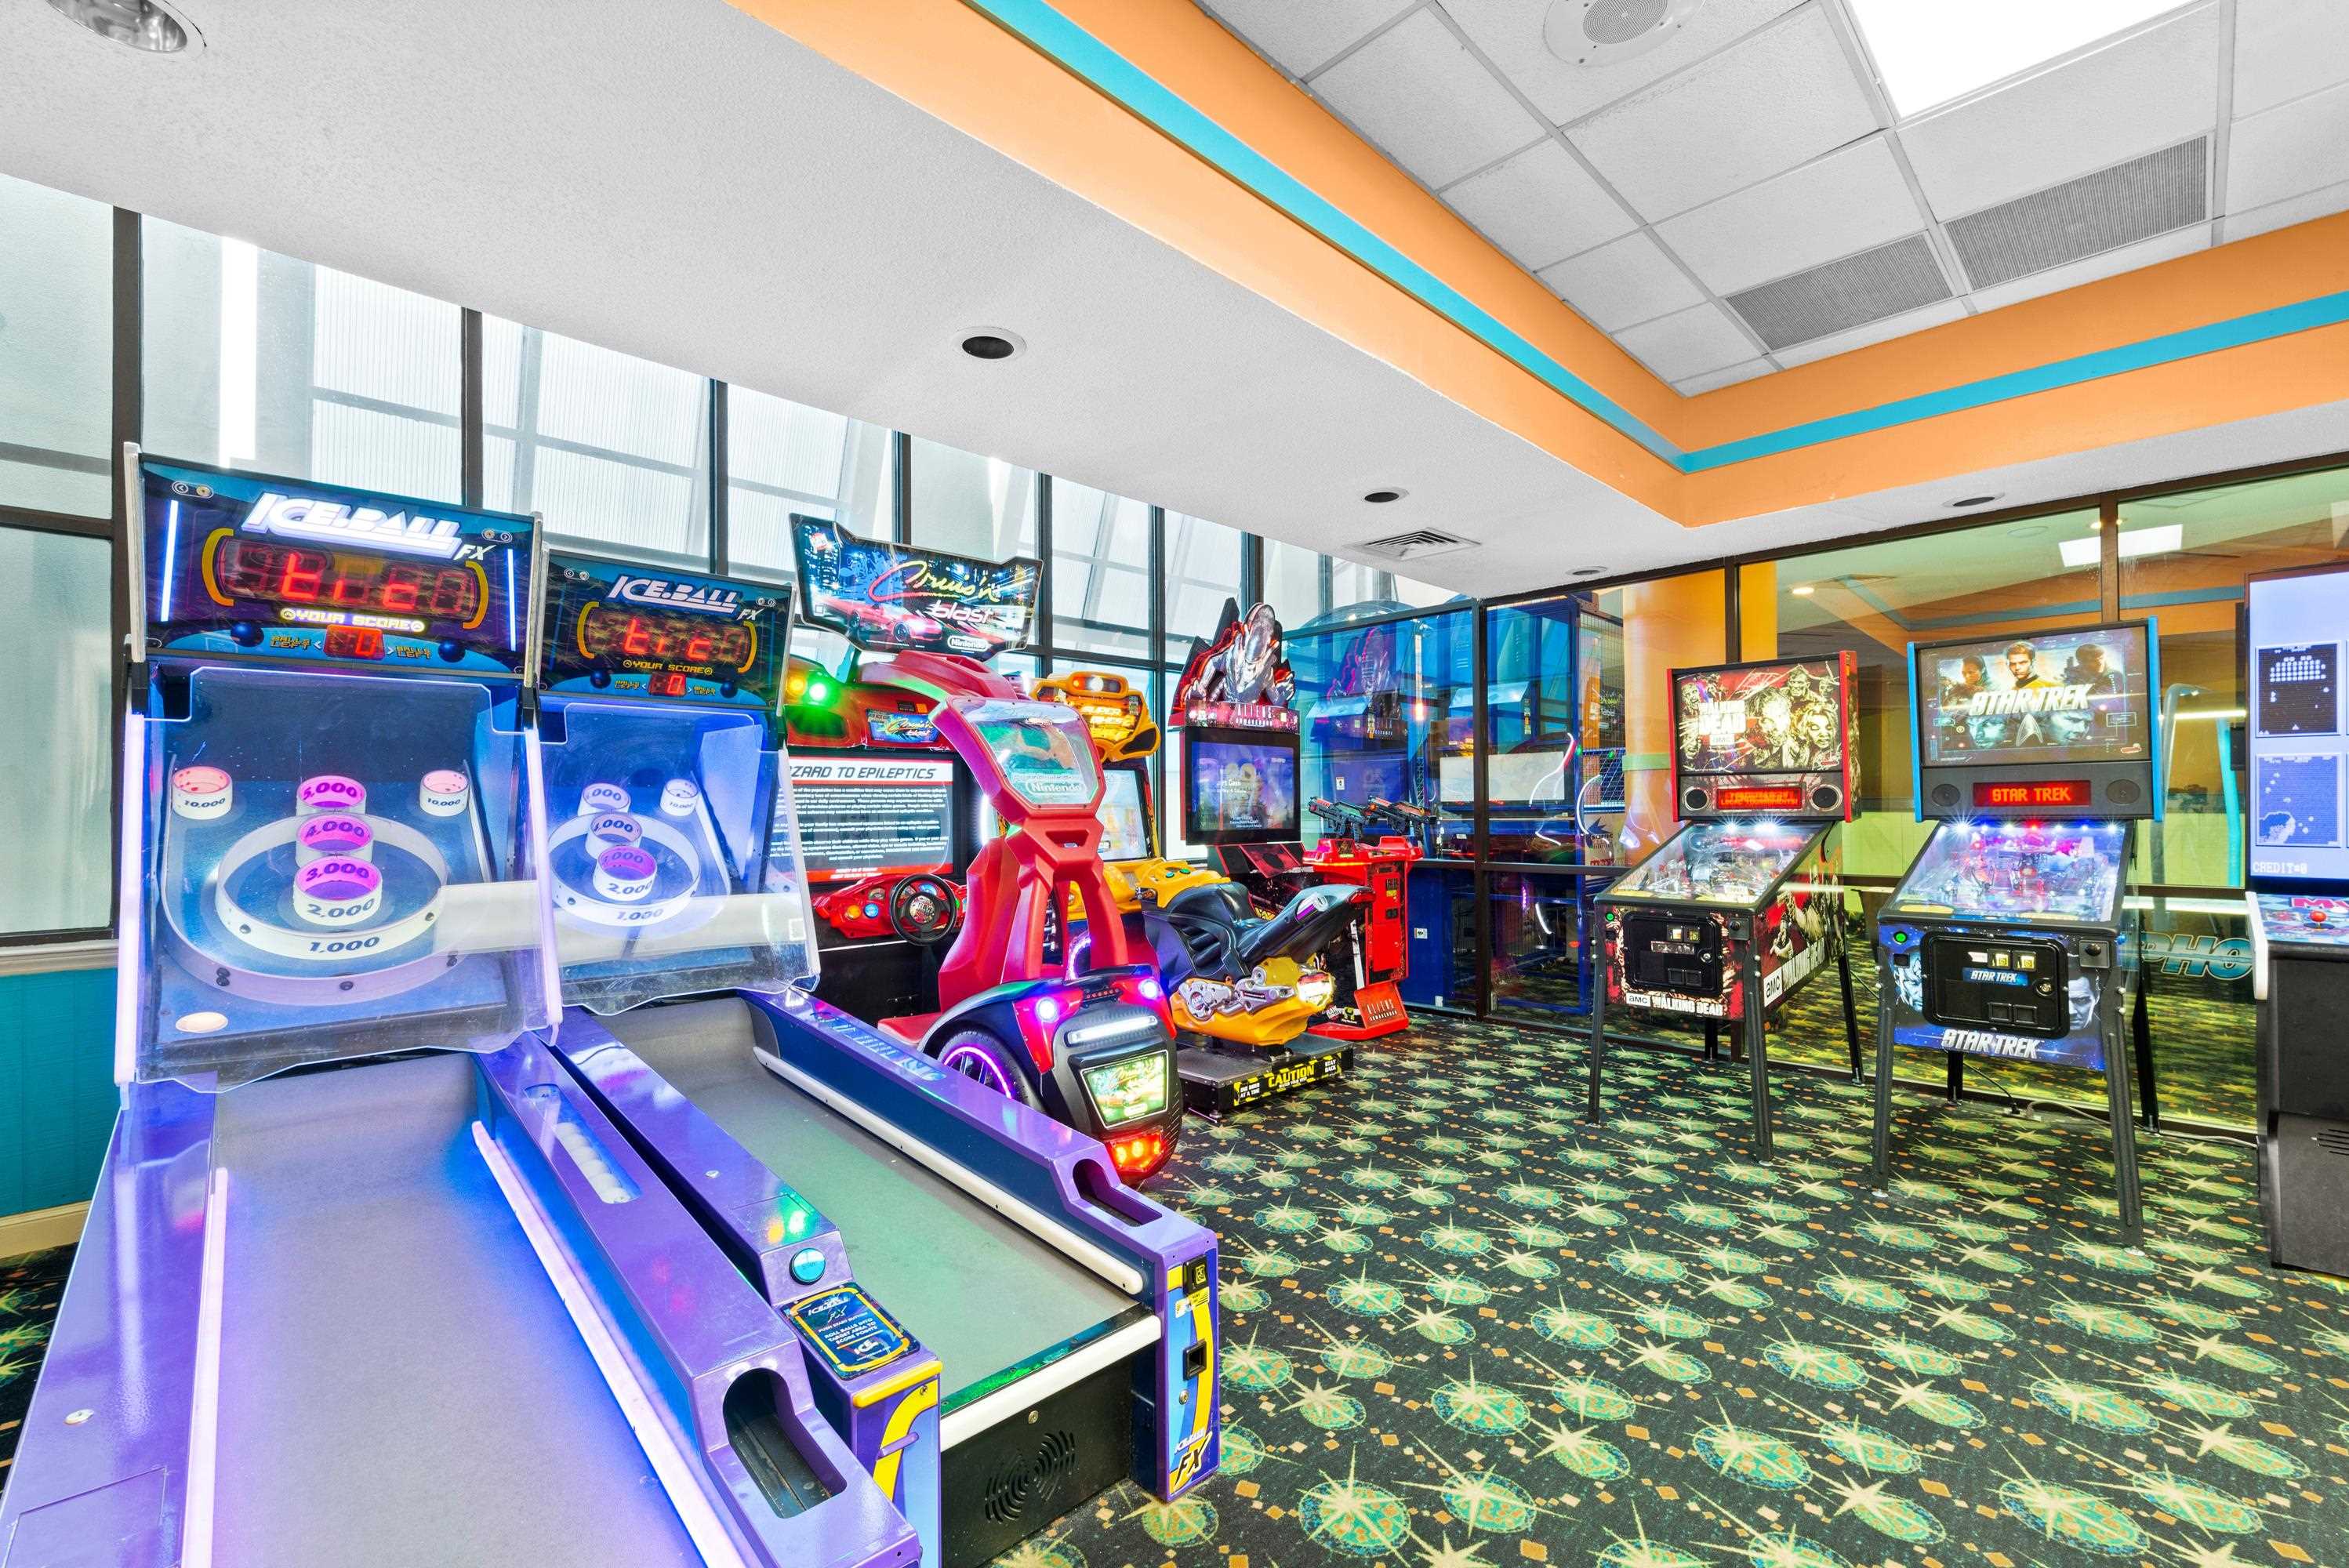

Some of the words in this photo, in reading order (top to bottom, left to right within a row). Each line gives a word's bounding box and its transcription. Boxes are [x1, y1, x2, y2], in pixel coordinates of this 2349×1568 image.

[452, 544, 496, 561] FX
[296, 610, 346, 624] YOUR
[351, 615, 412, 630] SCORE
[736, 608, 764, 621] FX
[632, 660, 663, 670] YOUR
[668, 664, 704, 674] SCORE
[1969, 688, 2034, 716] STAR
[2038, 684, 2095, 711] TREK
[1237, 704, 1272, 719] ALIENS
[790, 765, 832, 778] ZARD
[837, 766, 855, 779] TO
[857, 767, 937, 779] EPILEPTICS
[303, 782, 358, 800] 5,000
[1030, 782, 1080, 792] Nintendo
[1992, 788, 2028, 802] STAR
[2033, 787, 2071, 801] TREK
[304, 821, 365, 839] 4,000
[305, 862, 370, 882] 3,000
[608, 880, 652, 895] 2,000
[307, 898, 376, 918] 2,000
[616, 908, 665, 920] 1,000
[308, 936, 381, 954] 1,000
[1970, 970, 1997, 983] STAR
[1999, 971, 2017, 983] TREK
[1367, 998, 1394, 1015] ALIENS
[1650, 993, 1696, 1013] WALKING
[1696, 1000, 1723, 1017] DEAD
[1941, 1029, 1991, 1054] STAR
[1995, 1036, 2039, 1059] TREK
[1268, 1065, 1315, 1087] CAUTION
[825, 1330, 840, 1339] ROLL
[840, 1324, 859, 1333] BALLS
[828, 1332, 851, 1342] TARGET
[851, 1325, 867, 1334] AREA
[836, 1334, 856, 1345] SCORE
[856, 1326, 878, 1337] POINTS
[854, 1338, 879, 1355] ICE
[1174, 1431, 1213, 1488] FX
